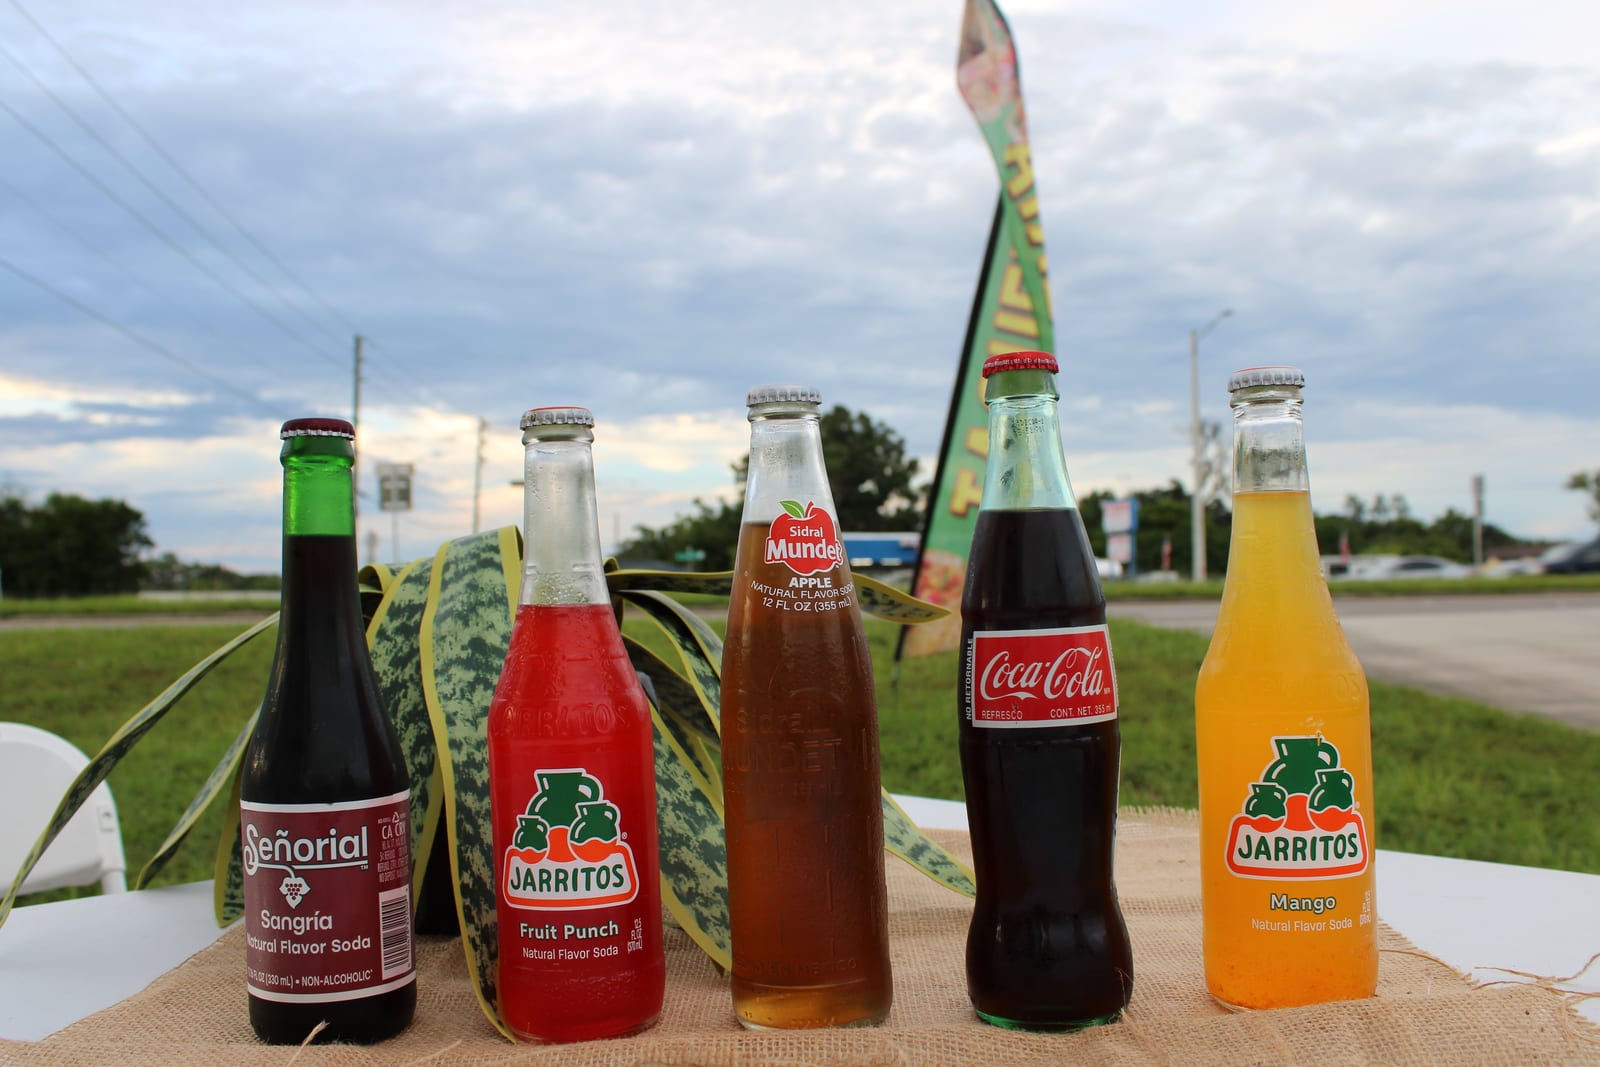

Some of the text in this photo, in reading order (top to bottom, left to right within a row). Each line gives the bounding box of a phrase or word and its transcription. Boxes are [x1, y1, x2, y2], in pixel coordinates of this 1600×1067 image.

[789, 526, 823, 538] Sidral
[766, 539, 842, 561] Mundet
[751, 580, 798, 599] NATURAL
[800, 588, 839, 599] FLAVOR
[788, 577, 832, 589] APPLE
[762, 597, 772, 608] 12
[776, 600, 790, 611] FL
[793, 602, 812, 612] OZ
[814, 601, 837, 613] (355
[980, 646, 1104, 700] Coca-Cola
[965, 706, 972, 720] NO
[982, 710, 1023, 720] REFRESCO
[1050, 708, 1075, 719] CONT.
[1077, 706, 1092, 716] NET.
[1094, 704, 1105, 714] 355
[382, 825, 393, 840] CA
[243, 823, 369, 876] Señorial
[1238, 832, 1358, 862] JARRITOS
[510, 863, 625, 893] JARRITOS
[1270, 893, 1336, 914] Mango
[260, 910, 333, 936] Sangría
[519, 921, 619, 940] Fruit Punch
[1251, 917, 1353, 932] Natural Flavor Soda
[280, 939, 326, 955] Flavor
[331, 935, 371, 953] Soda
[522, 945, 619, 960] Natural Flavor Soda
